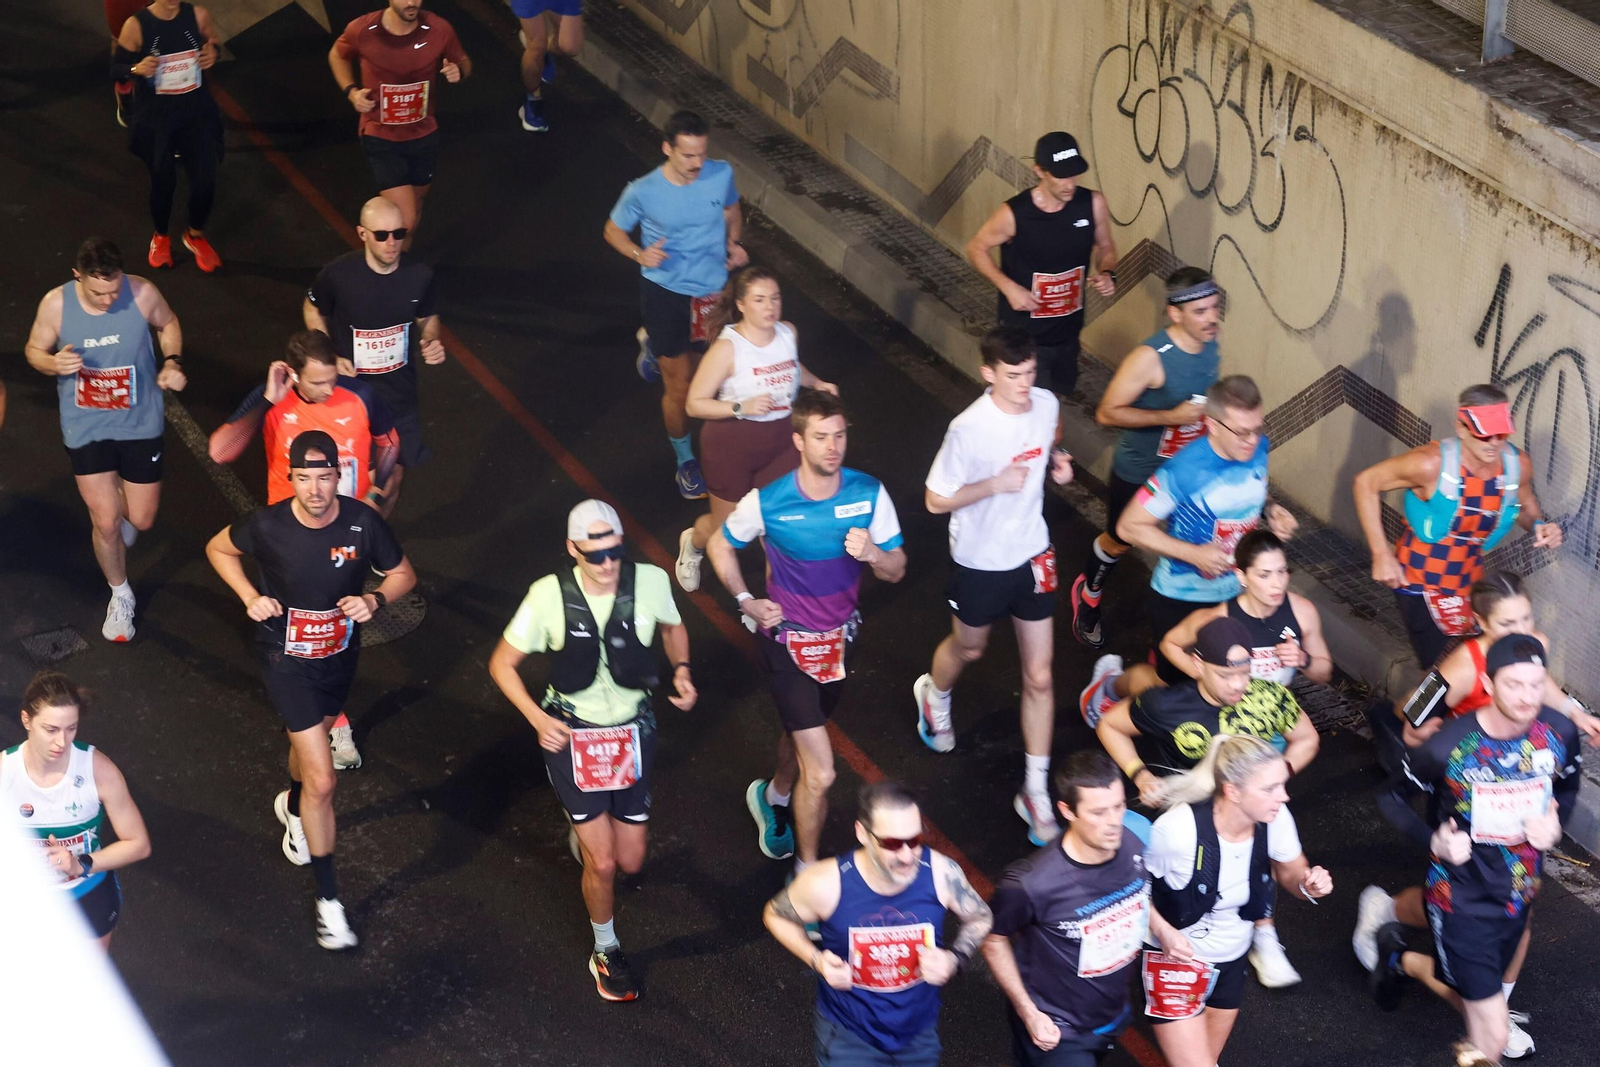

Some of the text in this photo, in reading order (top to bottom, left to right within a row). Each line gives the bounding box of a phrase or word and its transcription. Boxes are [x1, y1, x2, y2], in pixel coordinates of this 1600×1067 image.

[392, 94, 416, 103] 3187
[365, 337, 396, 350] 16162
[302, 621, 335, 635] 4445
[585, 742, 621, 758] 4412
